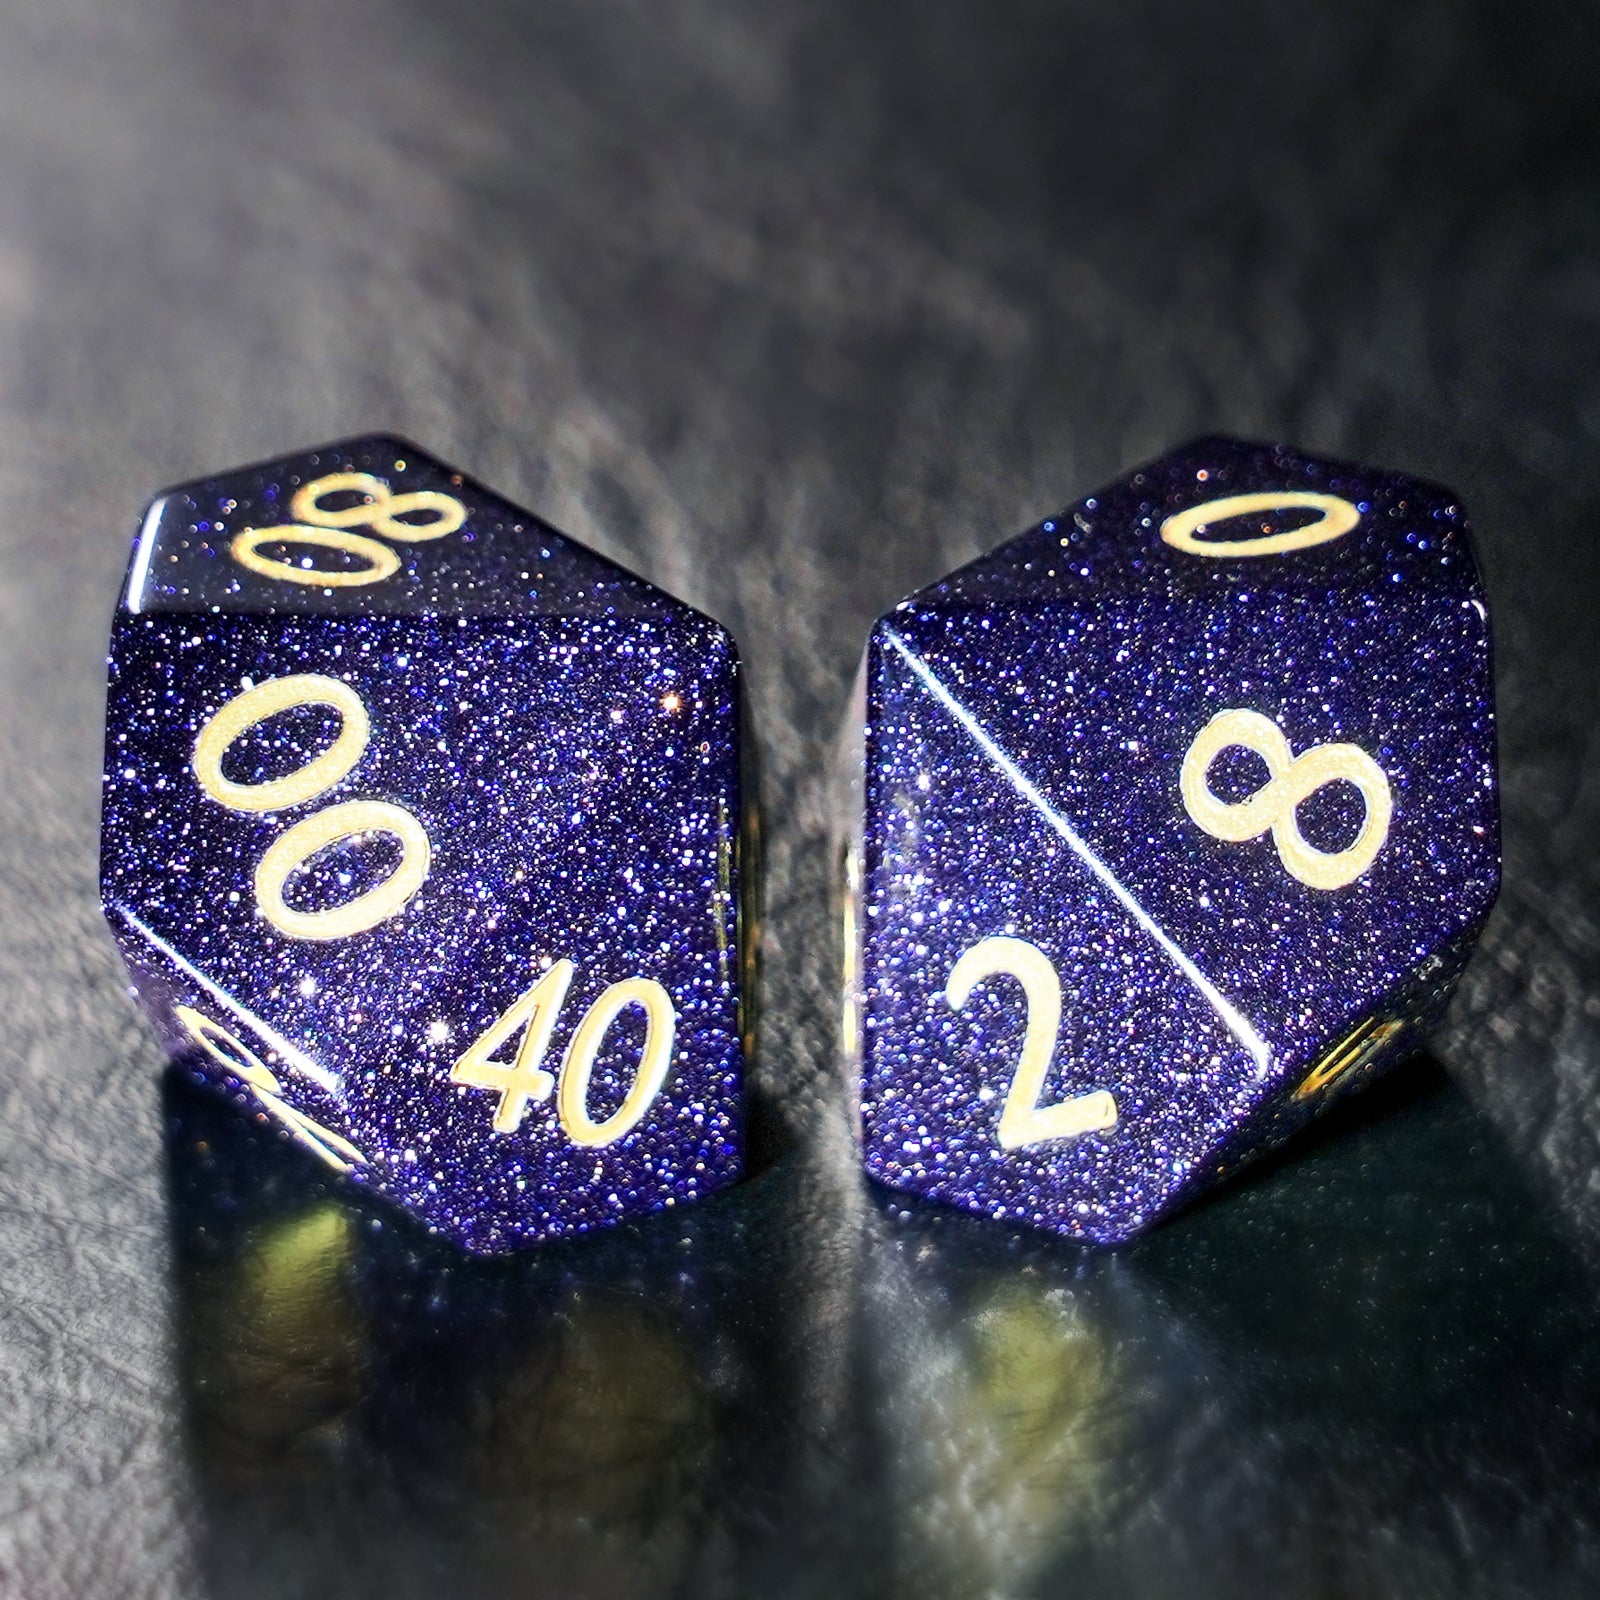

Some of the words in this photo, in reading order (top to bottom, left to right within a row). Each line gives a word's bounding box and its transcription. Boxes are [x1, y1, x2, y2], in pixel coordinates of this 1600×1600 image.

[231, 472, 467, 587] 80
[1161, 491, 1359, 557] 0
[192, 673, 432, 940] 00
[1180, 708, 1393, 890] 8
[450, 959, 674, 1149] 40
[945, 938, 1119, 1150] 2
